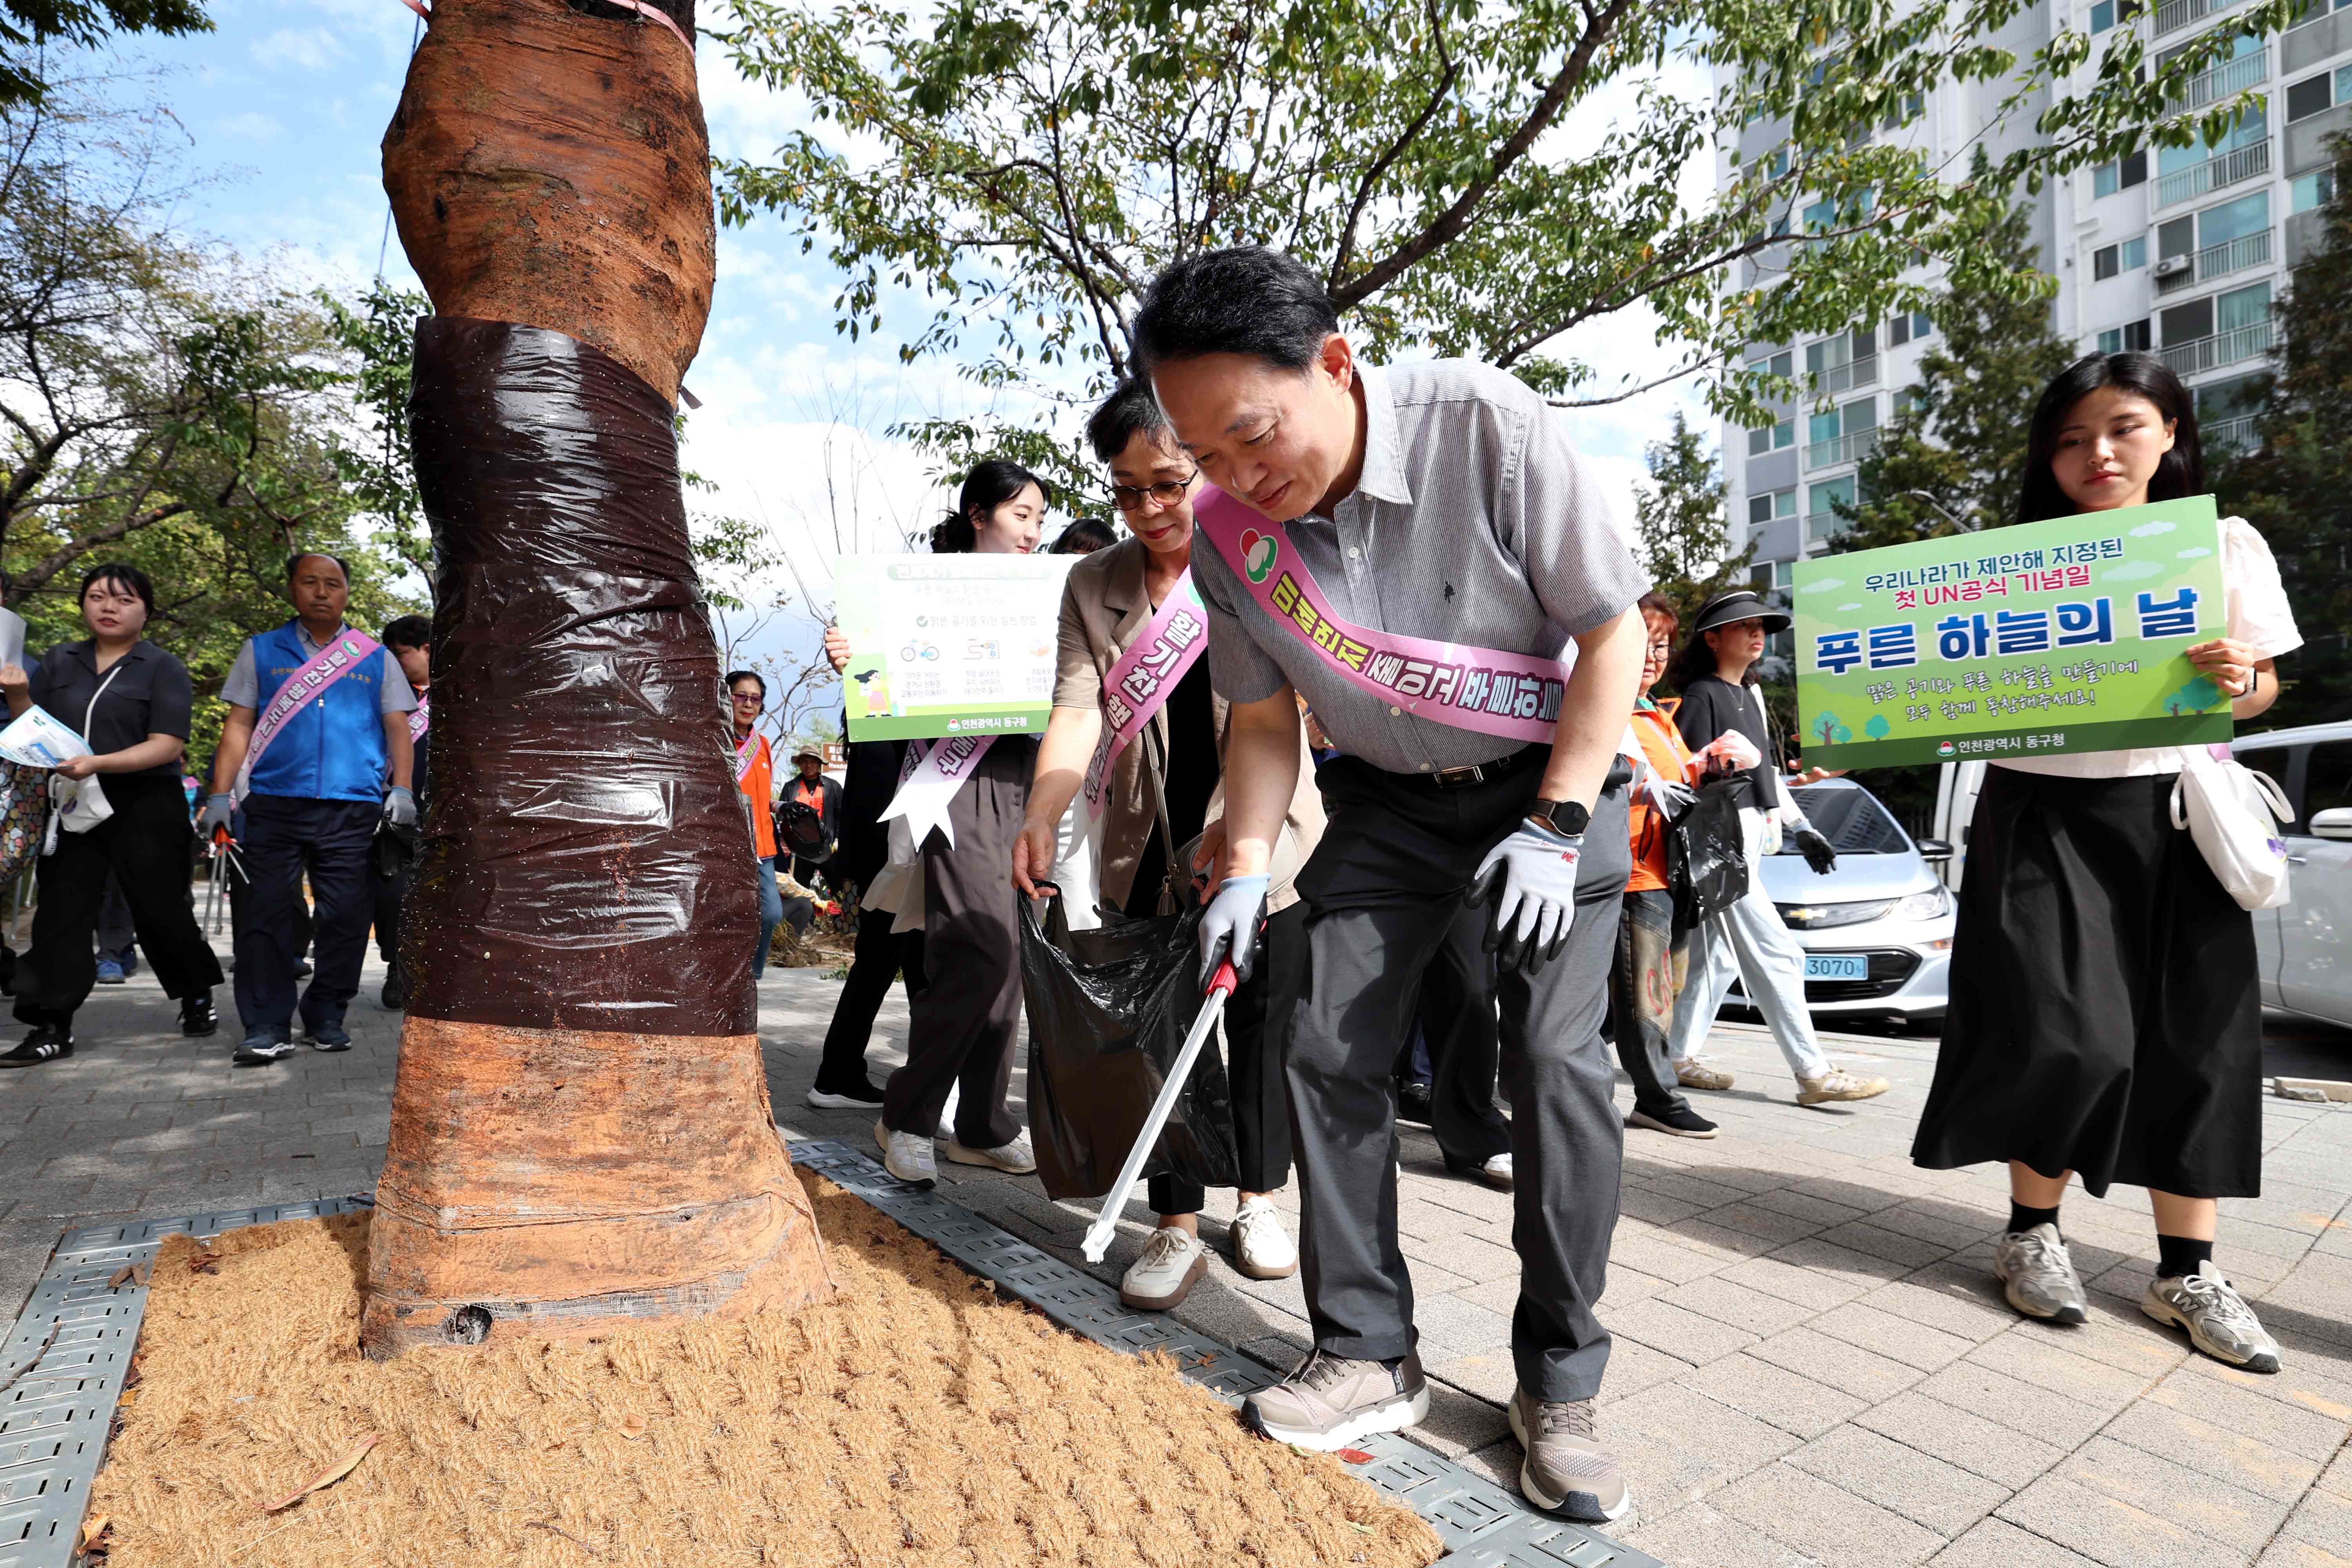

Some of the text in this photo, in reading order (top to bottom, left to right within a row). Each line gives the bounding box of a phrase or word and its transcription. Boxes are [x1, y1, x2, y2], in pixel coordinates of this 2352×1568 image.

[1865, 537, 2124, 592] 우리나라가 제안해 지정된
[1895, 564, 2091, 610] 첫 UN공식 기념일
[1270, 570, 1374, 673] 미세먼지
[1365, 652, 1463, 706] 줄이고
[1816, 586, 2199, 674] 푸른 하늘의 날
[301, 649, 349, 688] 활기찬
[1120, 608, 1203, 707] 활기찬
[1867, 659, 2139, 704] 맑은 공기와 푸른 하늘을 만들기에
[961, 717, 1027, 730] 인천광역시 동구청
[1906, 689, 2096, 722] 모두 함께 동참해주세요!
[1958, 733, 2066, 754] 인천광역시 동구청
[1808, 960, 1855, 975] 3070
